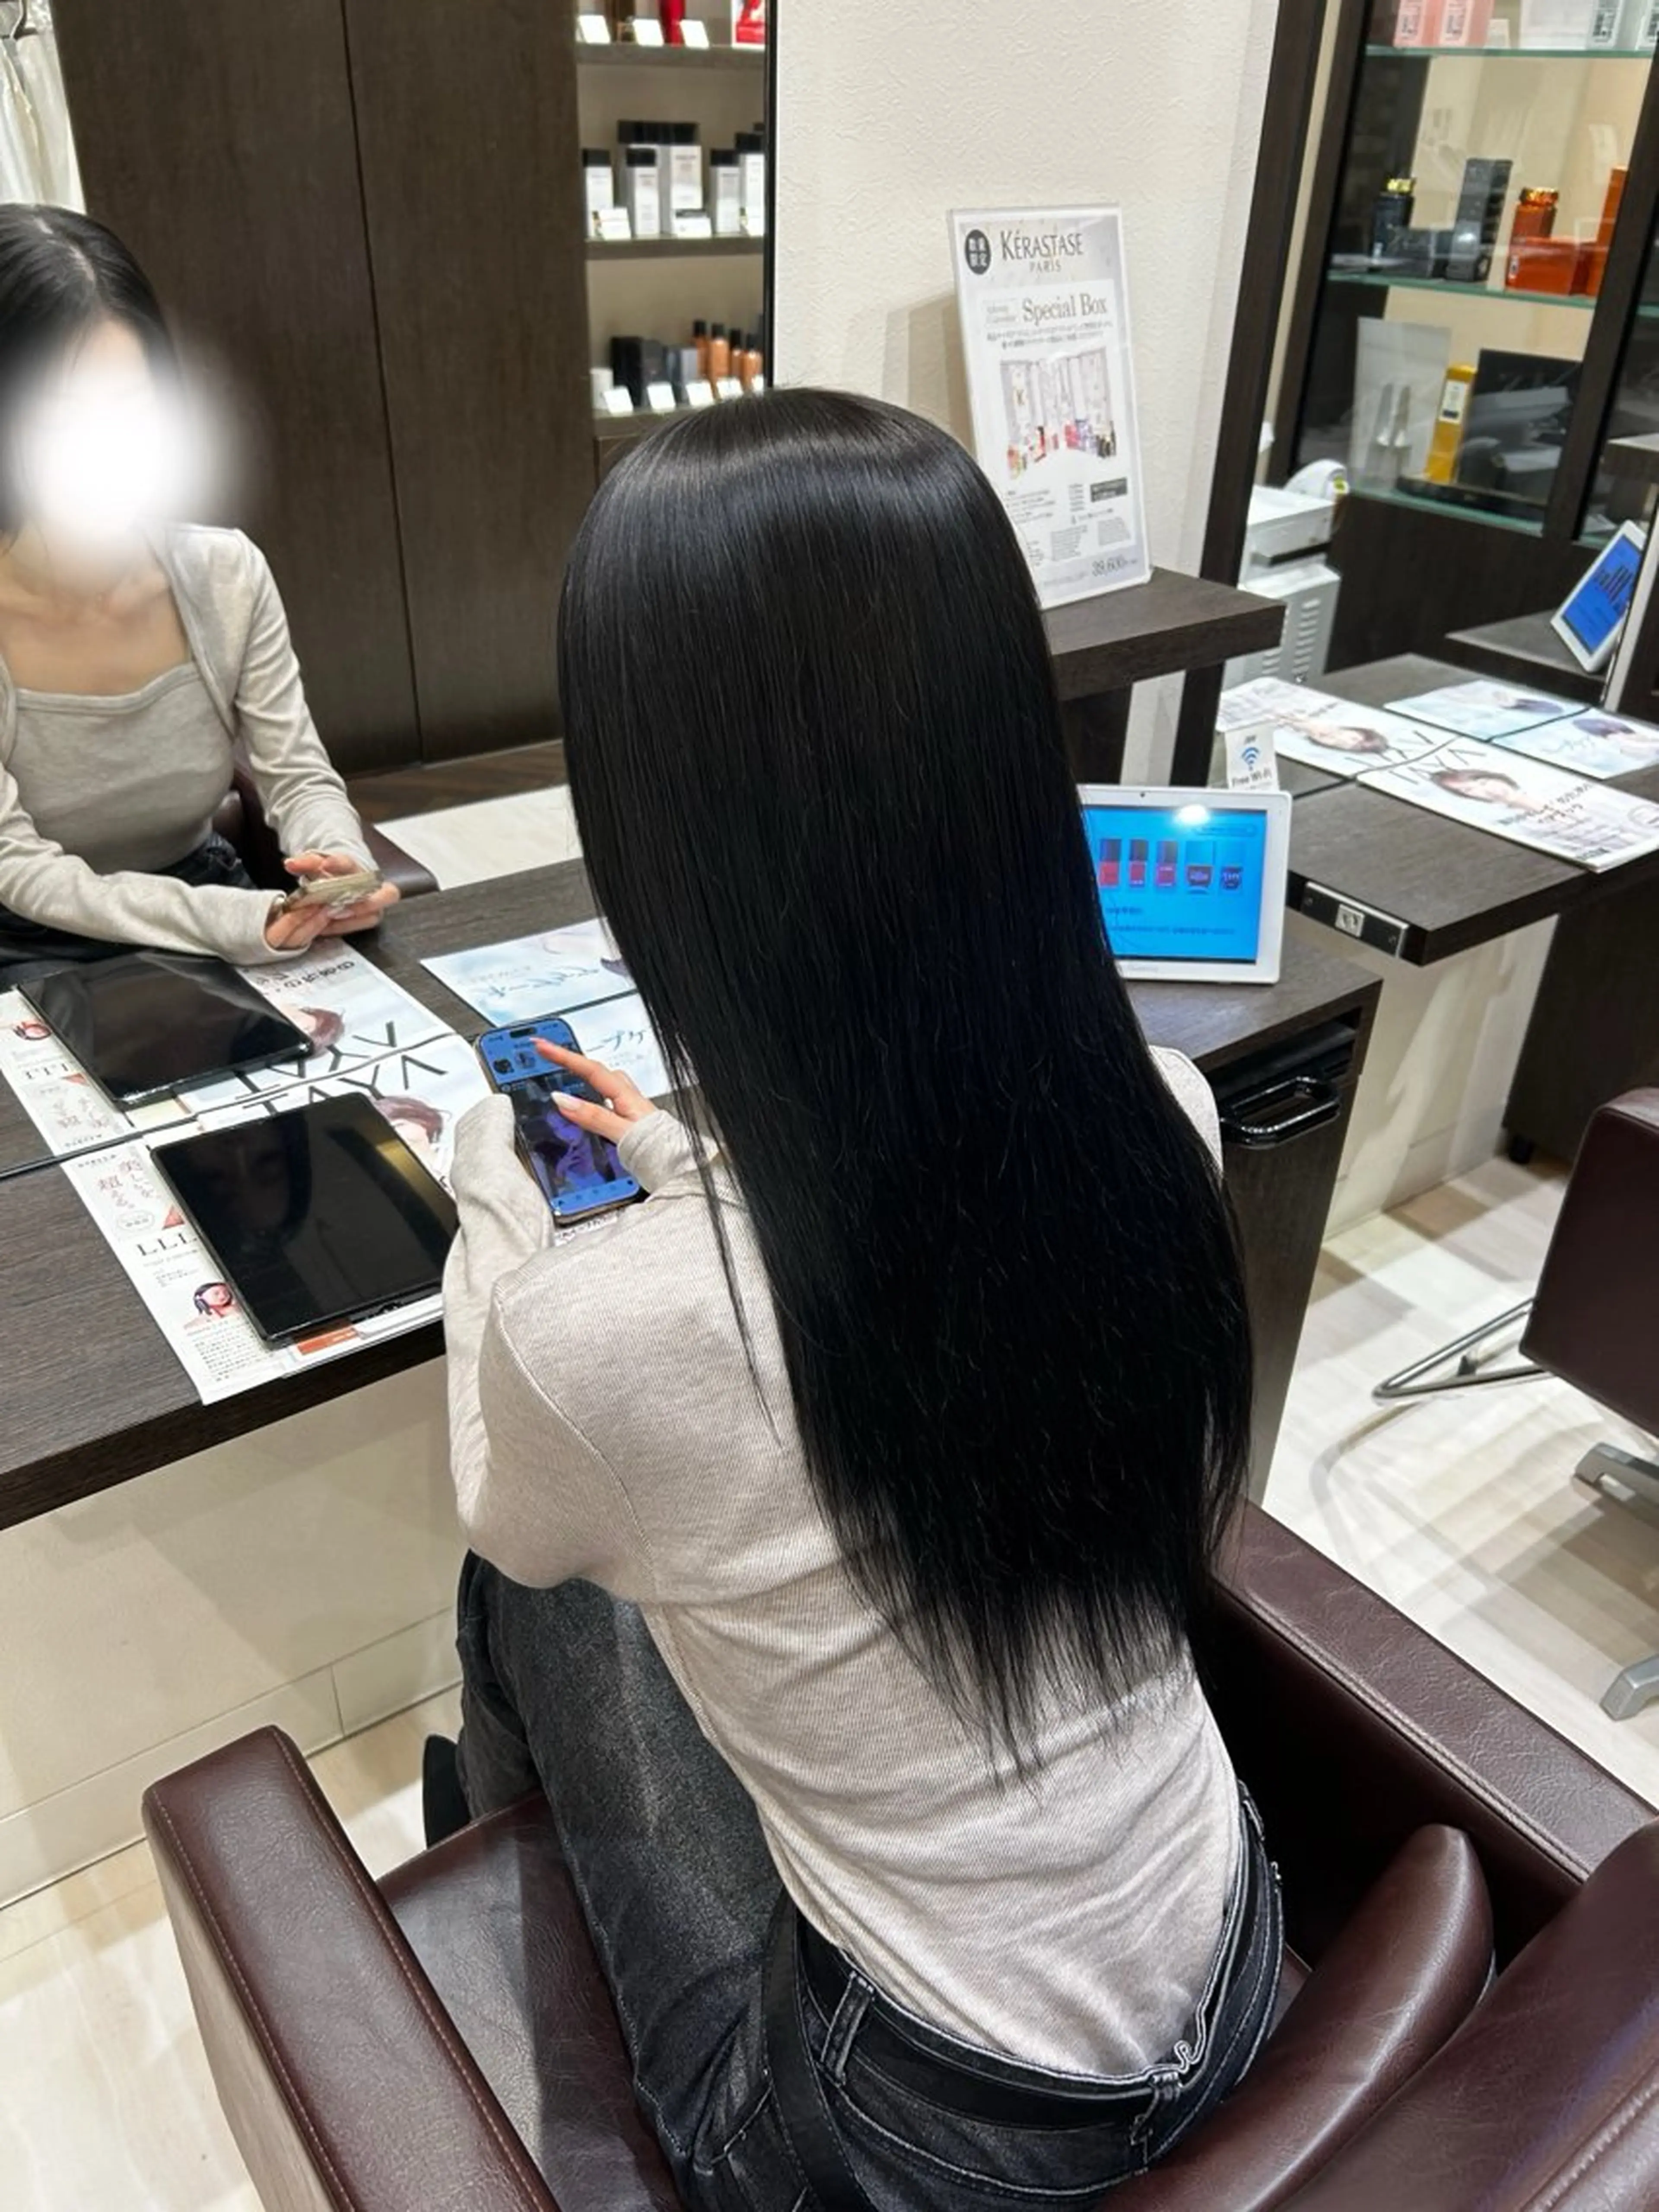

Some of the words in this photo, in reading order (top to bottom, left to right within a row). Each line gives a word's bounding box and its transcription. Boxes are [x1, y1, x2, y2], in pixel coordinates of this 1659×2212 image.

[1000, 229, 1084, 261] KÉRASTASE
[1029, 259, 1062, 273] PARIS
[1022, 295, 1076, 327] Special
[1080, 293, 1107, 316] Box
